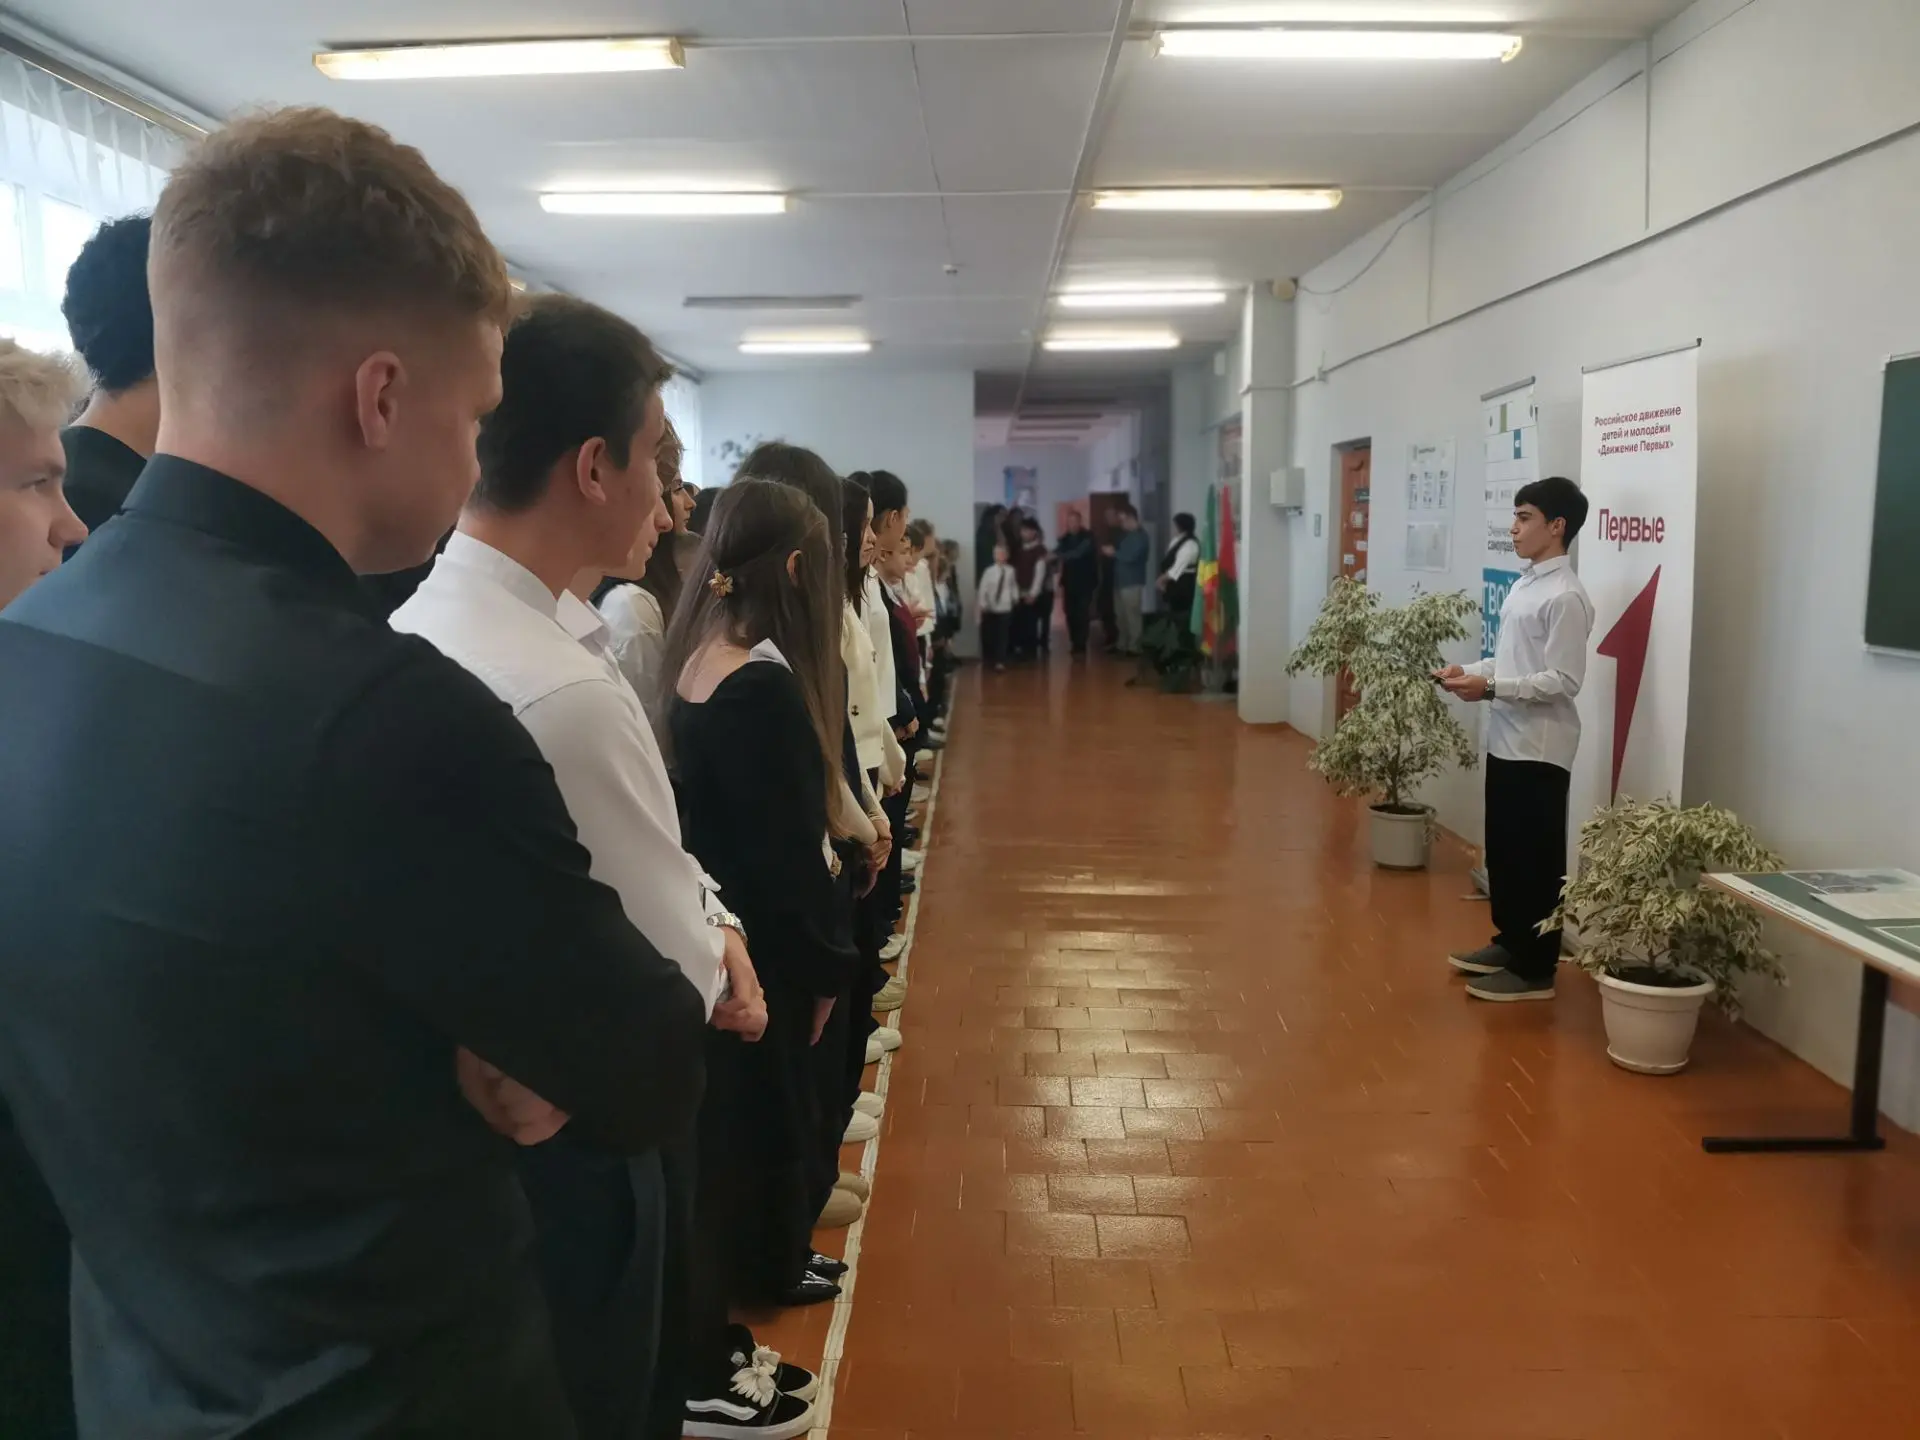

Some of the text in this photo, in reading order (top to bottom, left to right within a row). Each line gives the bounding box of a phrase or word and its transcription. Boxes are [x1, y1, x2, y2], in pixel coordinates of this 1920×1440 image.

[1594, 405, 1682, 427] Российское движение
[1601, 423, 1671, 442] детей и молодёжи
[1598, 439, 1674, 457] «Движение Первых»
[1598, 508, 1665, 552] Первые
